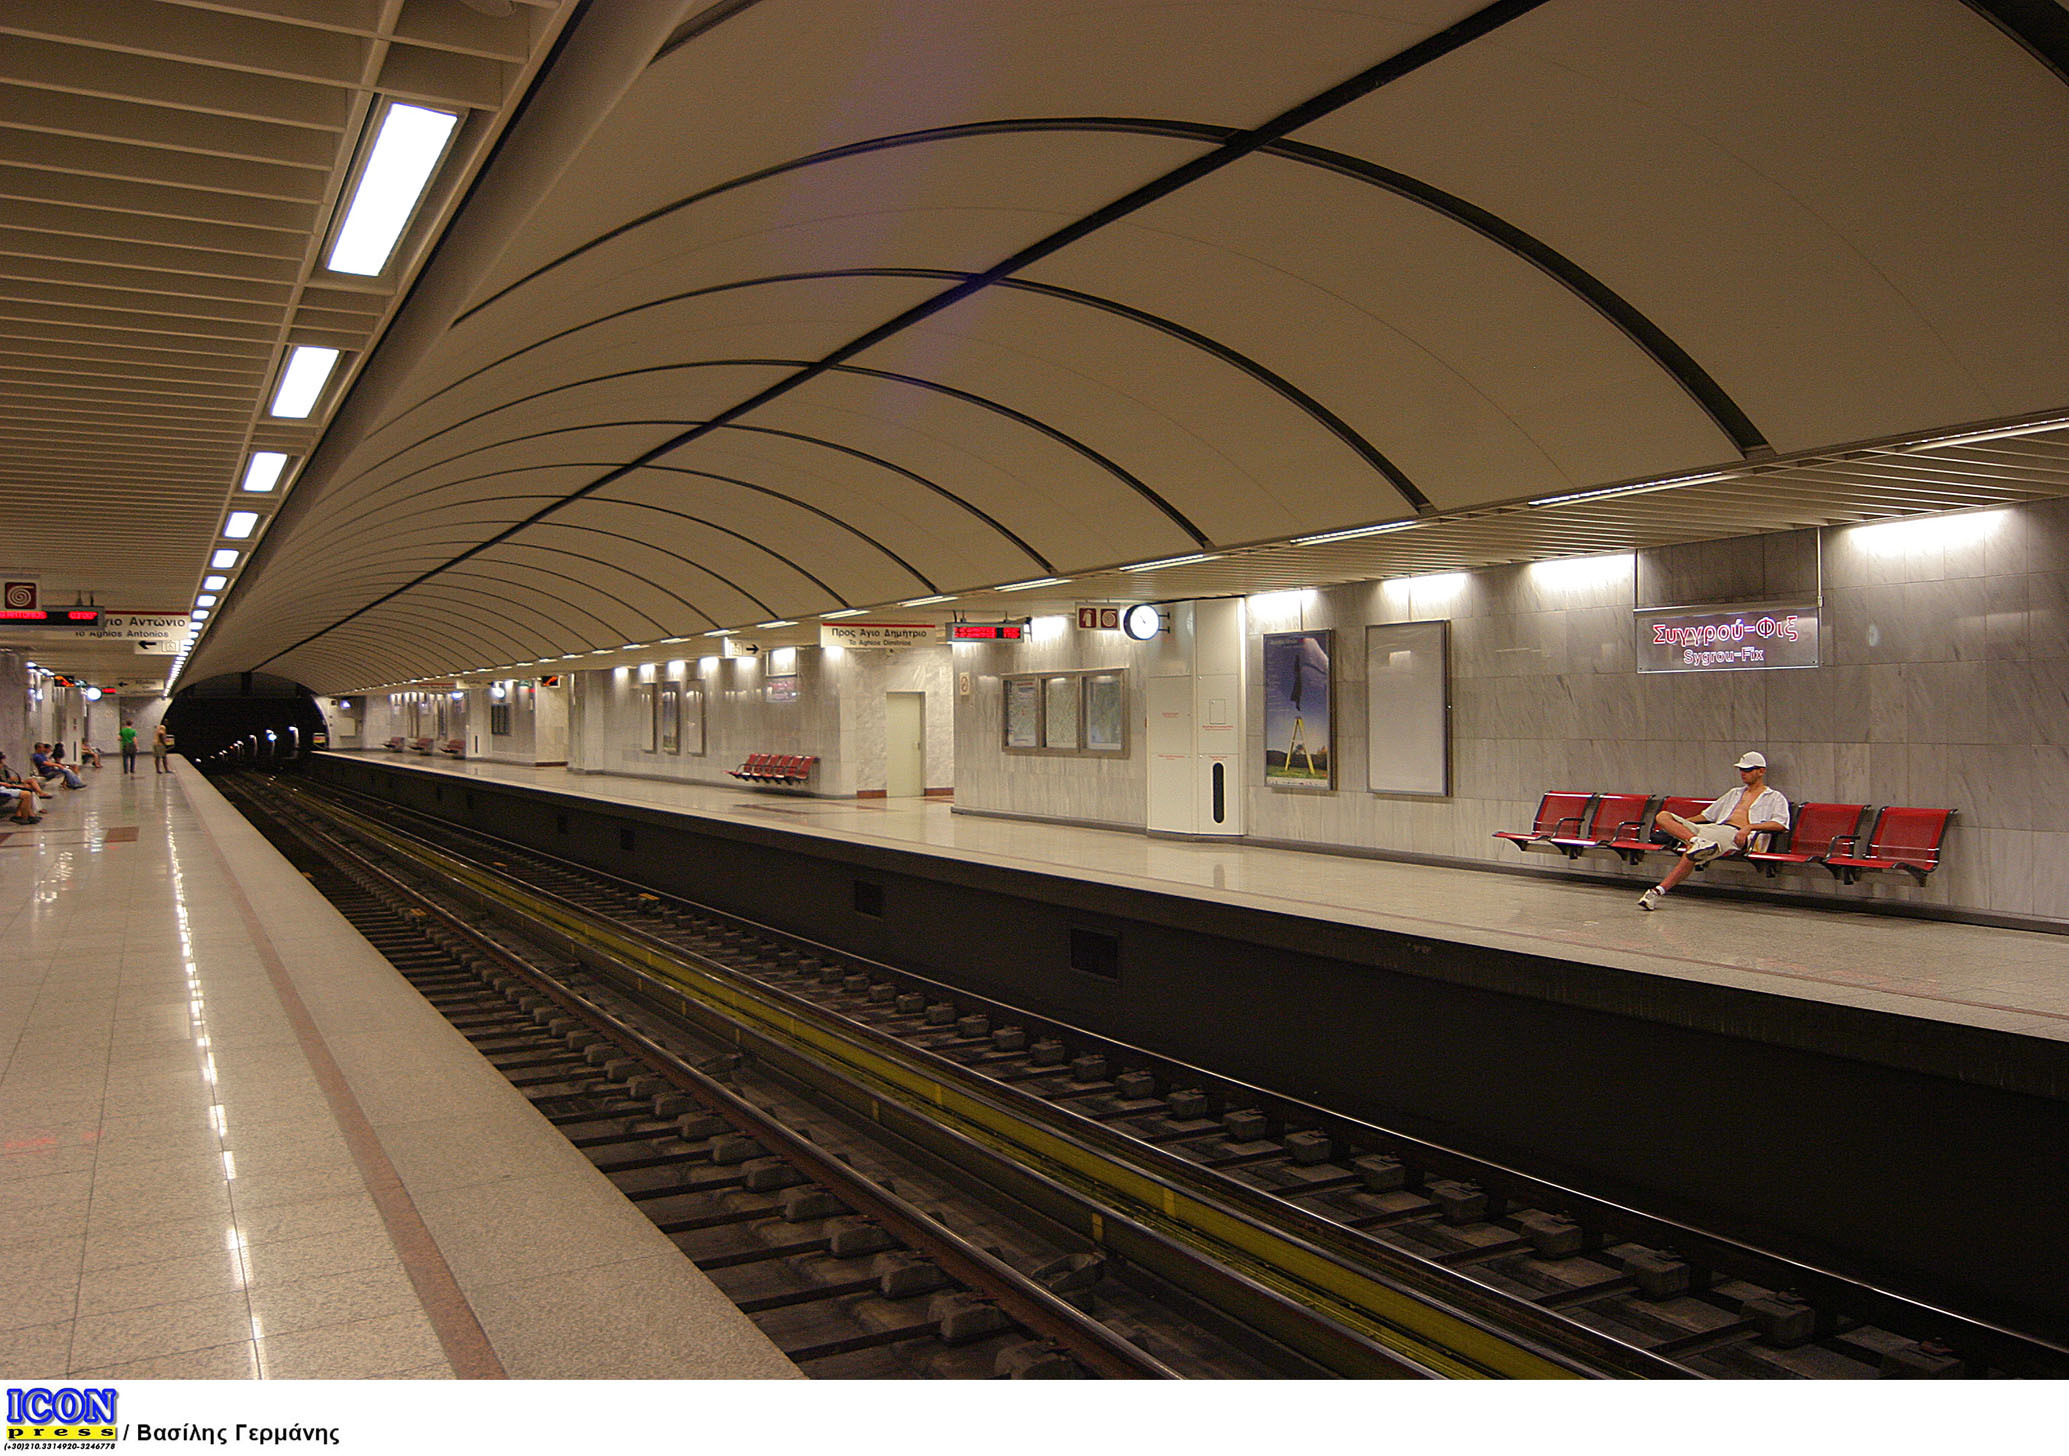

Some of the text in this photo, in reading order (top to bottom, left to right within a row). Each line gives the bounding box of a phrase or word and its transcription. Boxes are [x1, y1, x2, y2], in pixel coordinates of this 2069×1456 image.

[130, 617, 185, 626] Αντώνιο
[127, 630, 169, 638] Antonios
[832, 628, 856, 638] Προς
[1652, 615, 1798, 647] Συγγρού-Φιξ
[1683, 646, 1764, 667] Sygrou-Fix
